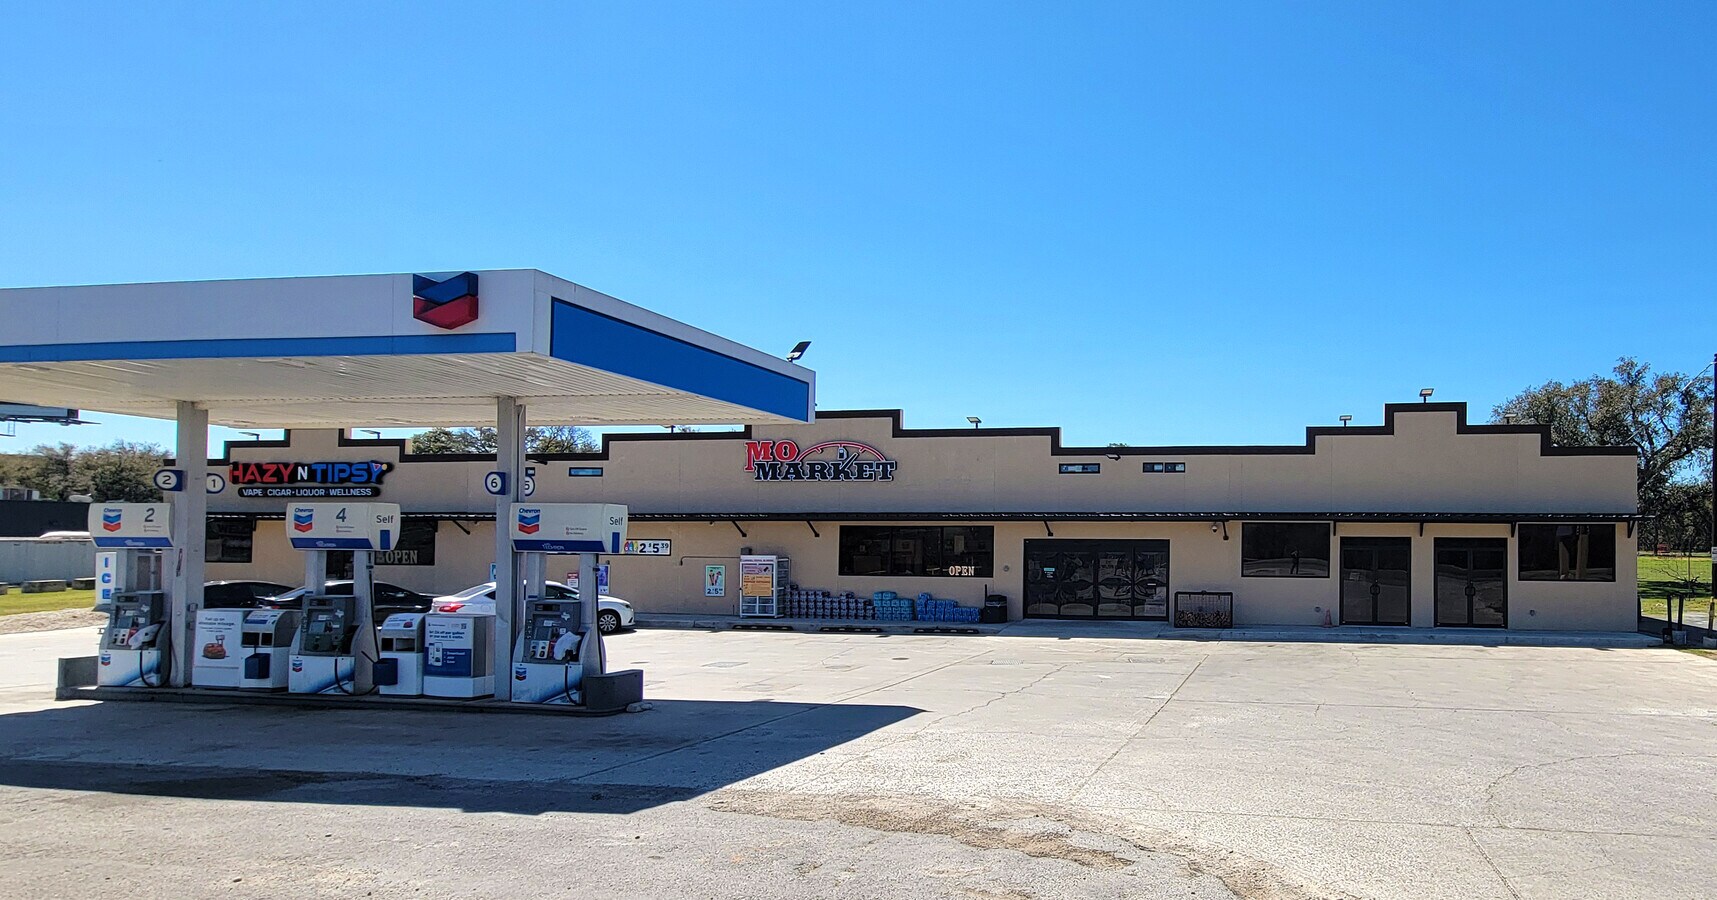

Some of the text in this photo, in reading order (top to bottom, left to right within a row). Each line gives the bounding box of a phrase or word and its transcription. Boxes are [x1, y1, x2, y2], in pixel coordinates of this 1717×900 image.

[745, 439, 799, 472] MO
[229, 461, 384, 483] HAZY N TIPSY
[755, 457, 896, 481] MARKET
[162, 475, 172, 485] 2
[490, 477, 498, 489] 6
[242, 488, 372, 497] VAPE CIGAR LIQUOR WELLNESS
[144, 507, 155, 522] 2
[335, 507, 347, 522] 4
[376, 515, 395, 524] Self
[609, 516, 623, 526] Self
[639, 542, 647, 553] 2
[385, 550, 418, 564] OPEN
[948, 565, 975, 576] OPEN
